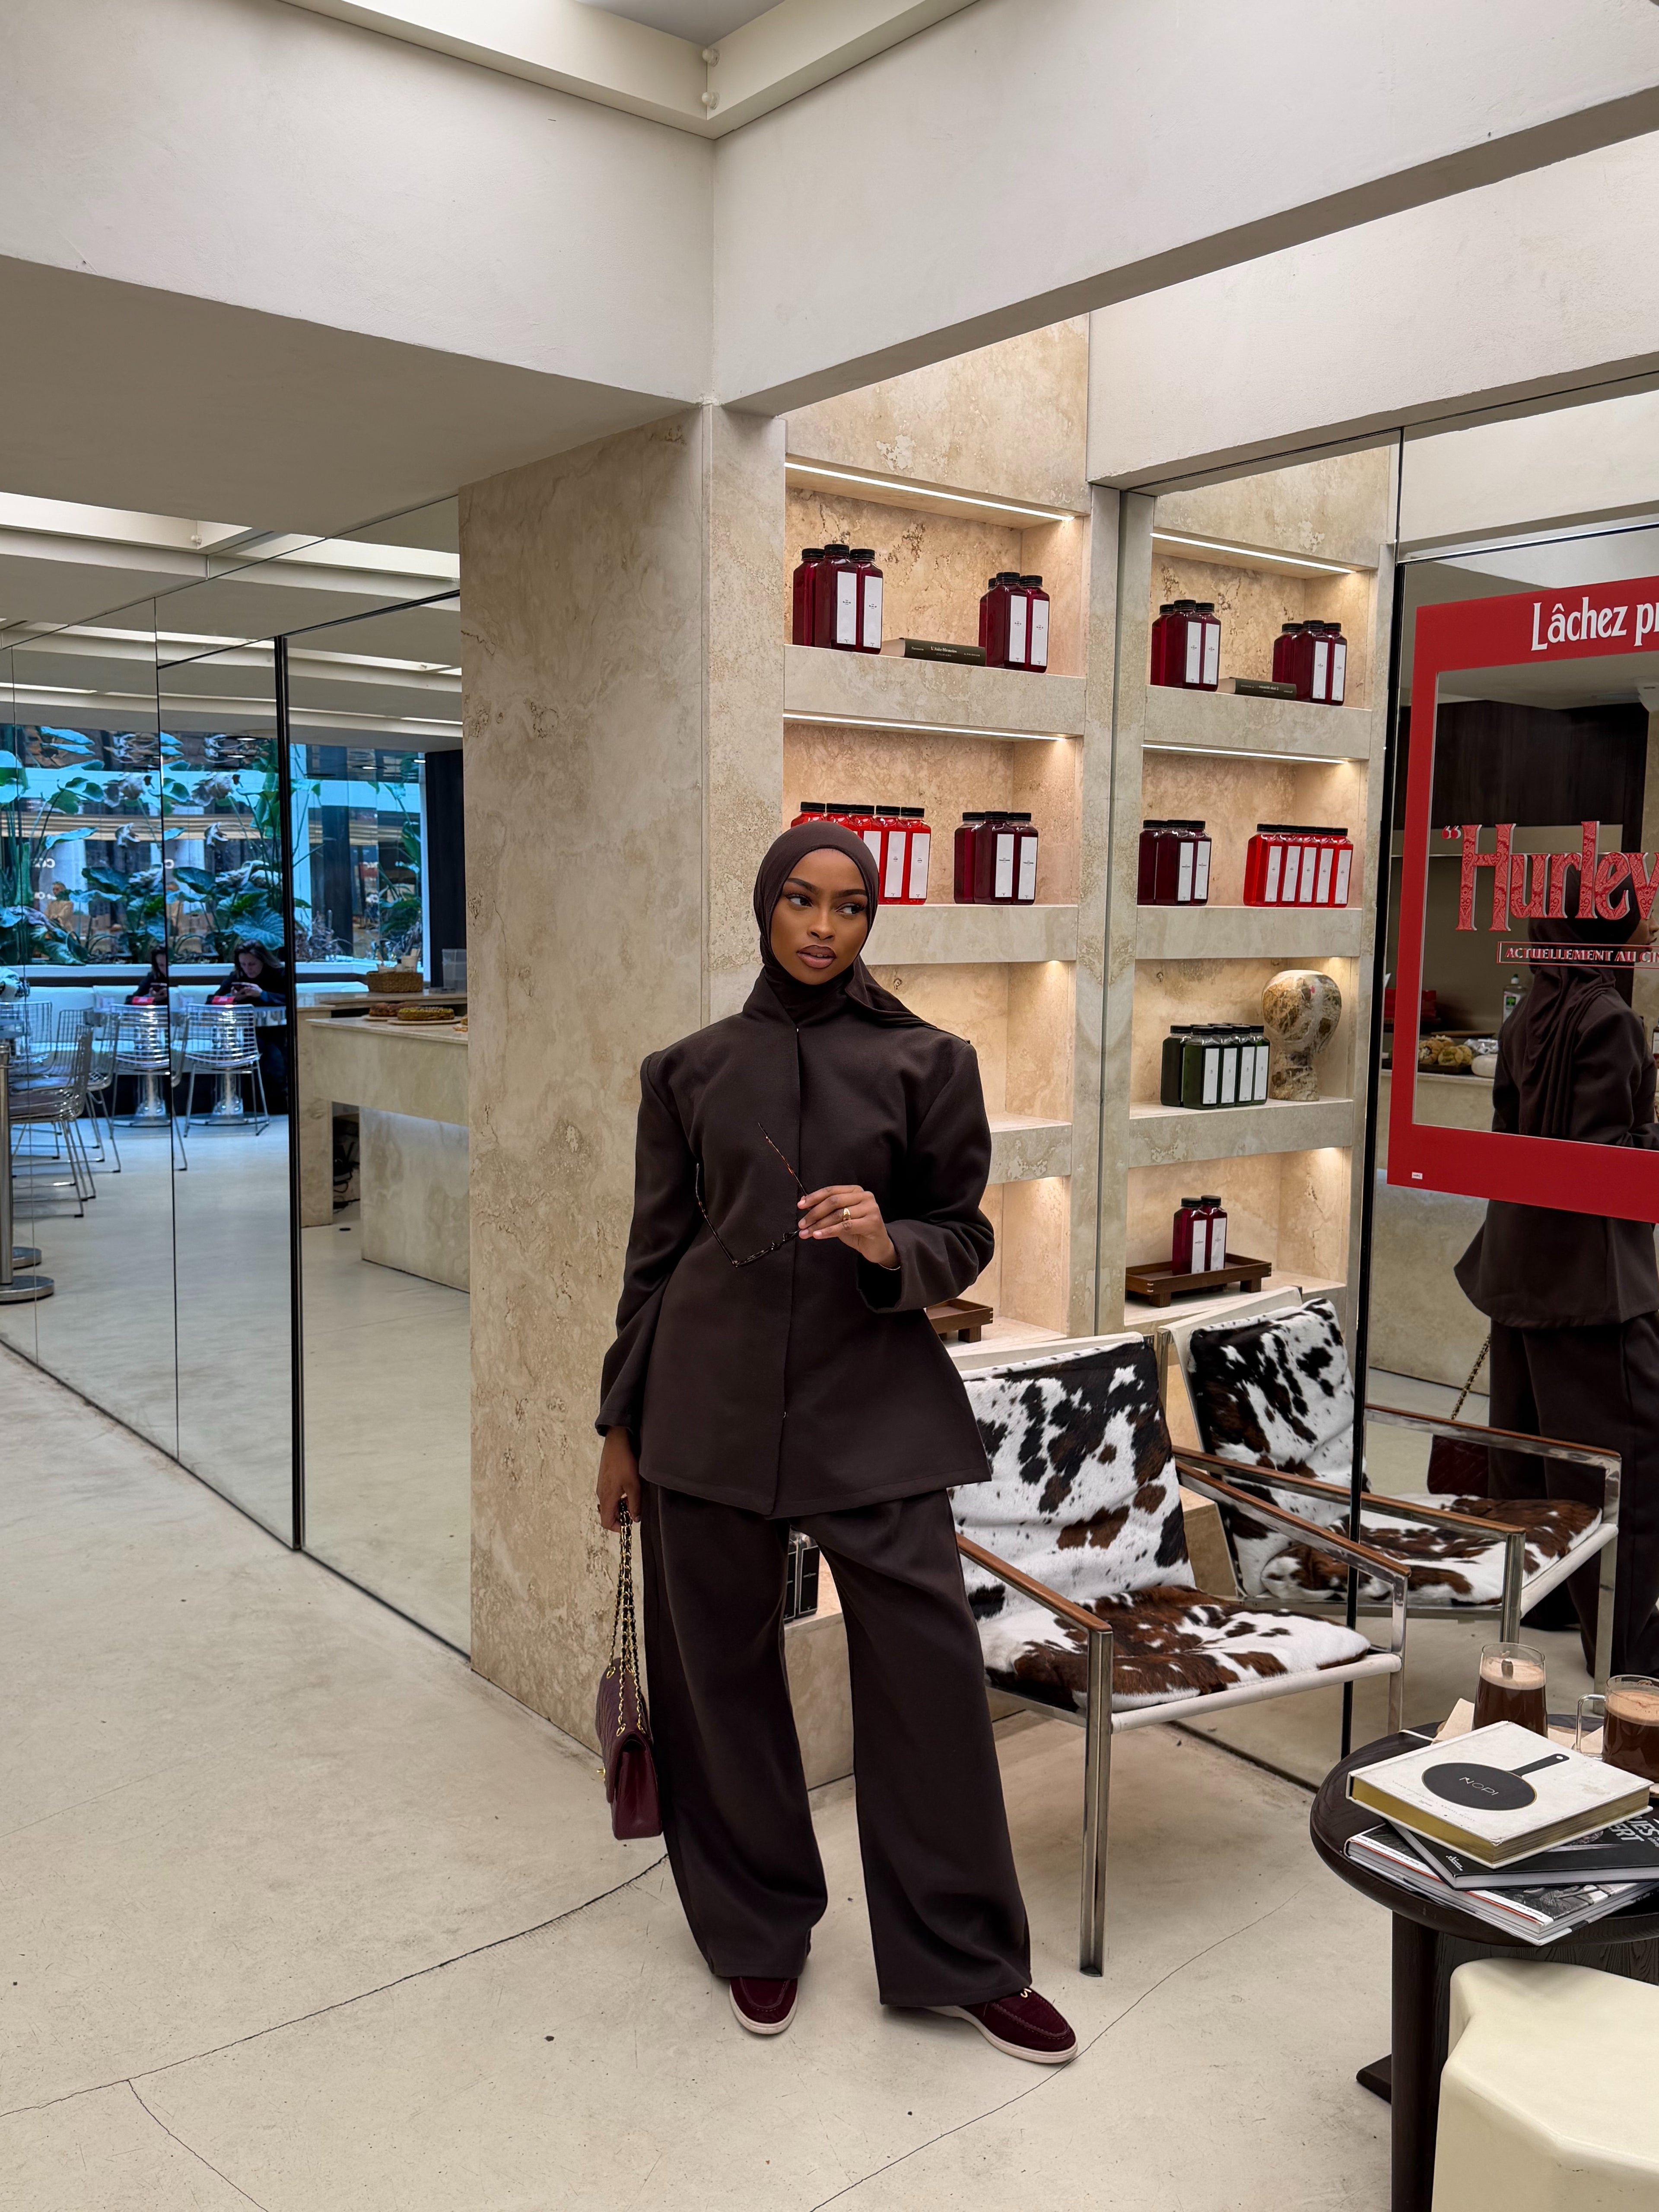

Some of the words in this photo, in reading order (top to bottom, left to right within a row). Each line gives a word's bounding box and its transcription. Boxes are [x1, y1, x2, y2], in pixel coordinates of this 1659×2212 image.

[1531, 596, 1628, 651] Lâchez
[1504, 947, 1614, 961] ACTUELLEMENT
[1614, 950, 1637, 962] AU
[1459, 1777, 1499, 1796] NOPI
